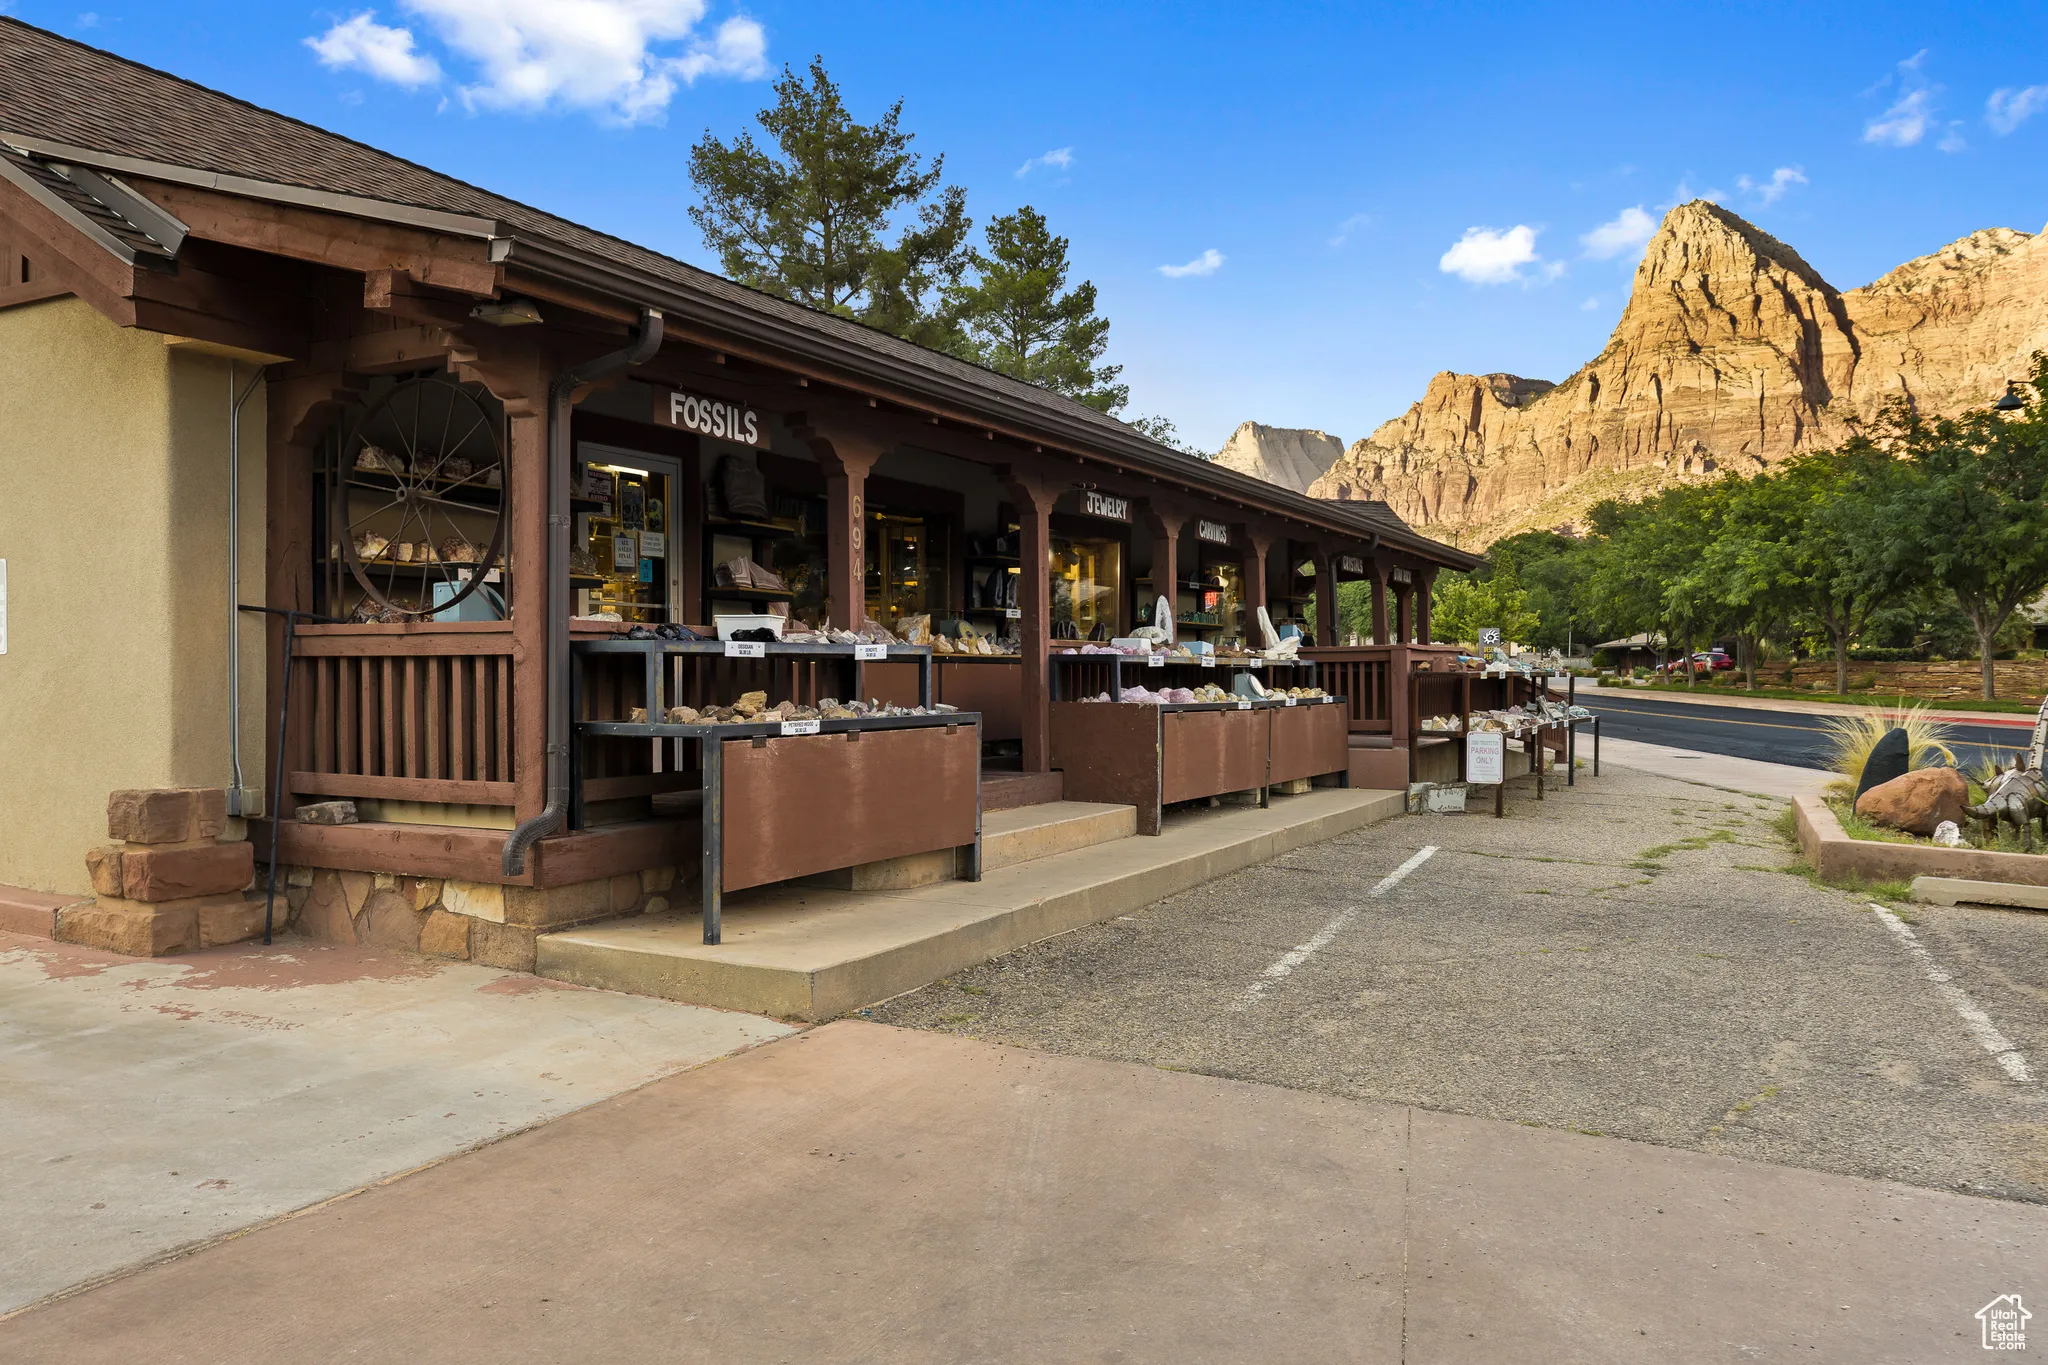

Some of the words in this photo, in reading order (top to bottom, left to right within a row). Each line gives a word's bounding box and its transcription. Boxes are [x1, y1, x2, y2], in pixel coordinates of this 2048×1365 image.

[671, 392, 758, 444] FOSSILS
[1087, 491, 1128, 520] JEWELRY
[1199, 519, 1227, 544] CARVINGS
[1342, 555, 1364, 574] CRYSTALS
[1470, 746, 1499, 755] PARKING
[1475, 756, 1494, 765] ONLY
